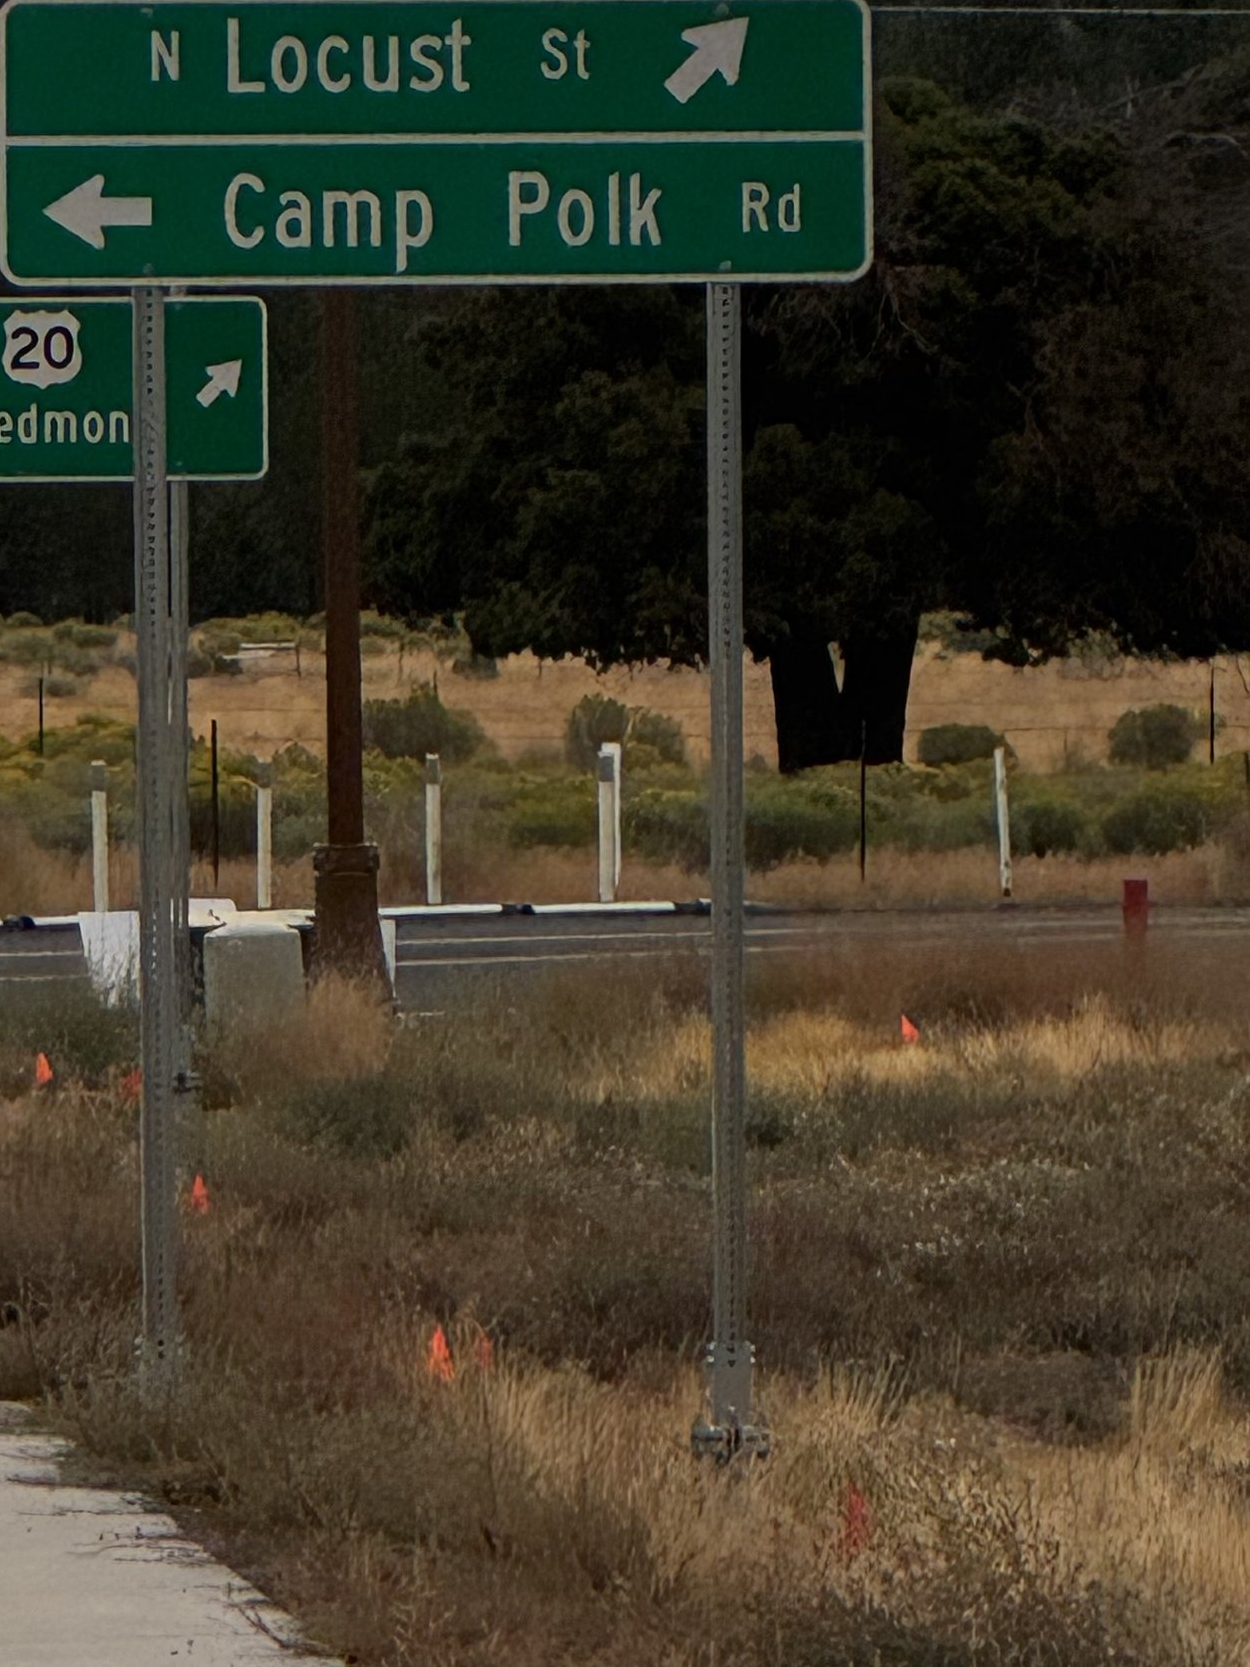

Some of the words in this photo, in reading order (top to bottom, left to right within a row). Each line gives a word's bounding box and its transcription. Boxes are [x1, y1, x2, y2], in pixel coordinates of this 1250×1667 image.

[150, 30, 181, 83] N
[226, 17, 473, 94] Locust
[540, 28, 591, 80] St
[223, 171, 435, 273] Camp
[508, 170, 663, 248] Polk
[741, 181, 802, 234] Rd
[9, 325, 76, 371] 20
